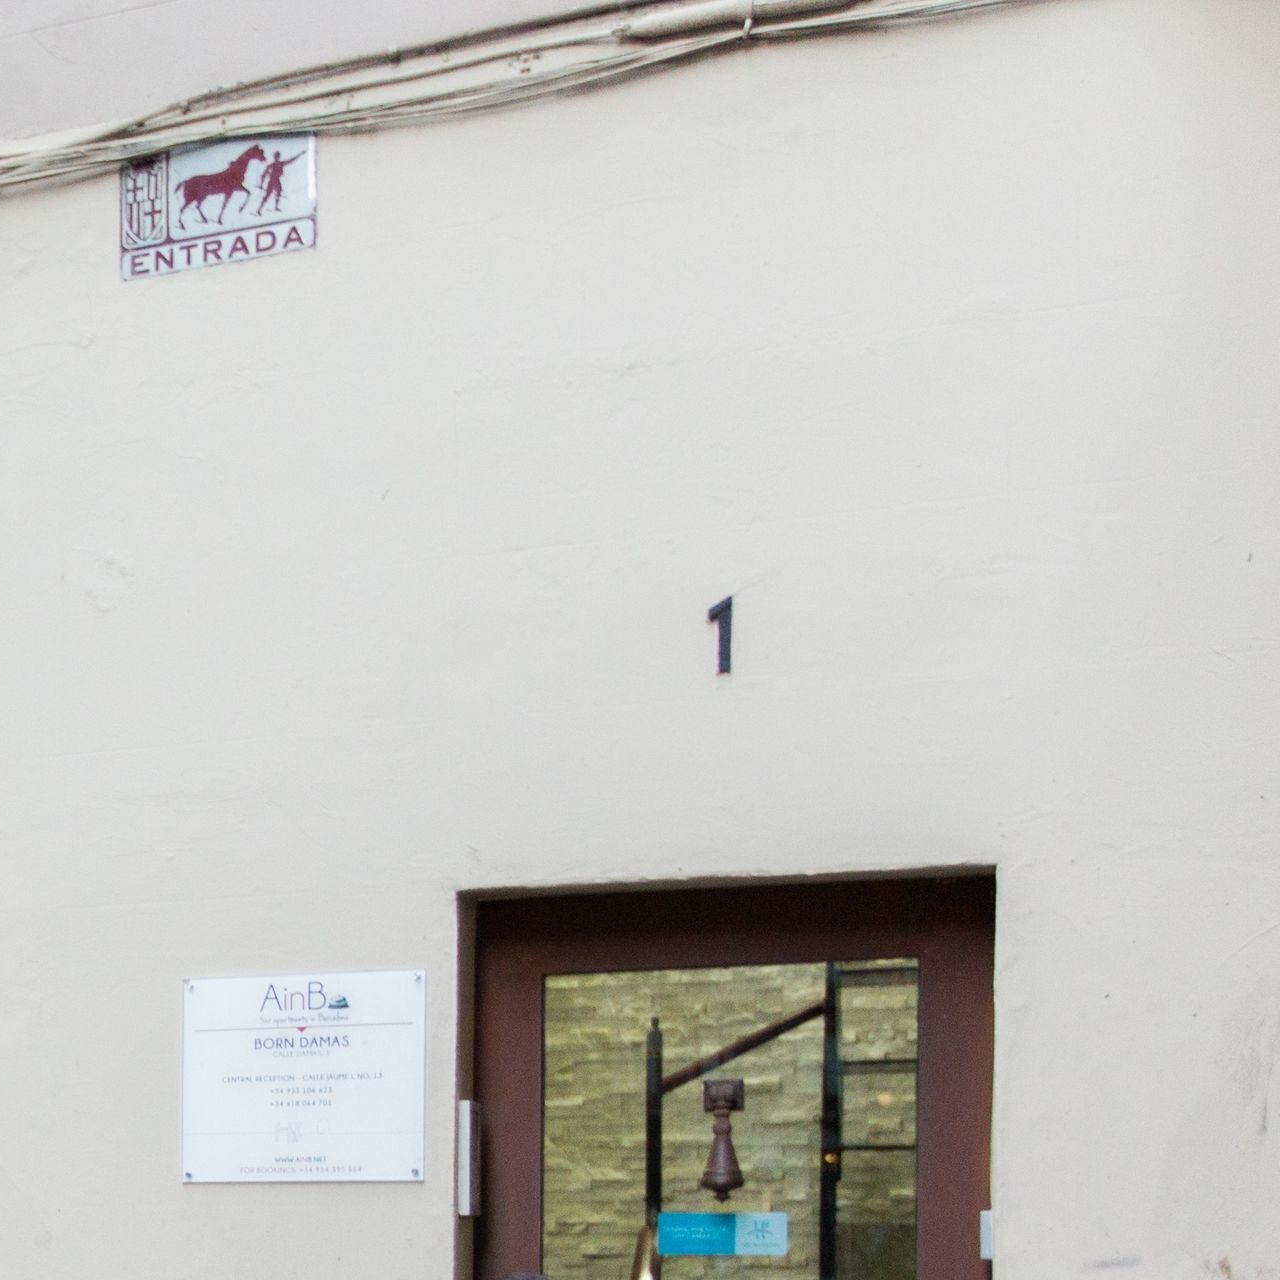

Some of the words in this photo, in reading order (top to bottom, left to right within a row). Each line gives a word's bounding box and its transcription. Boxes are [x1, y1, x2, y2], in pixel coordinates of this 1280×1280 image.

[130, 226, 305, 276] ENTRADA
[707, 595, 733, 675] 1
[260, 981, 326, 1012] AinB
[254, 1038, 294, 1050] BORN
[300, 1035, 350, 1048] DAMAS
[223, 1075, 253, 1084] CENTRAL
